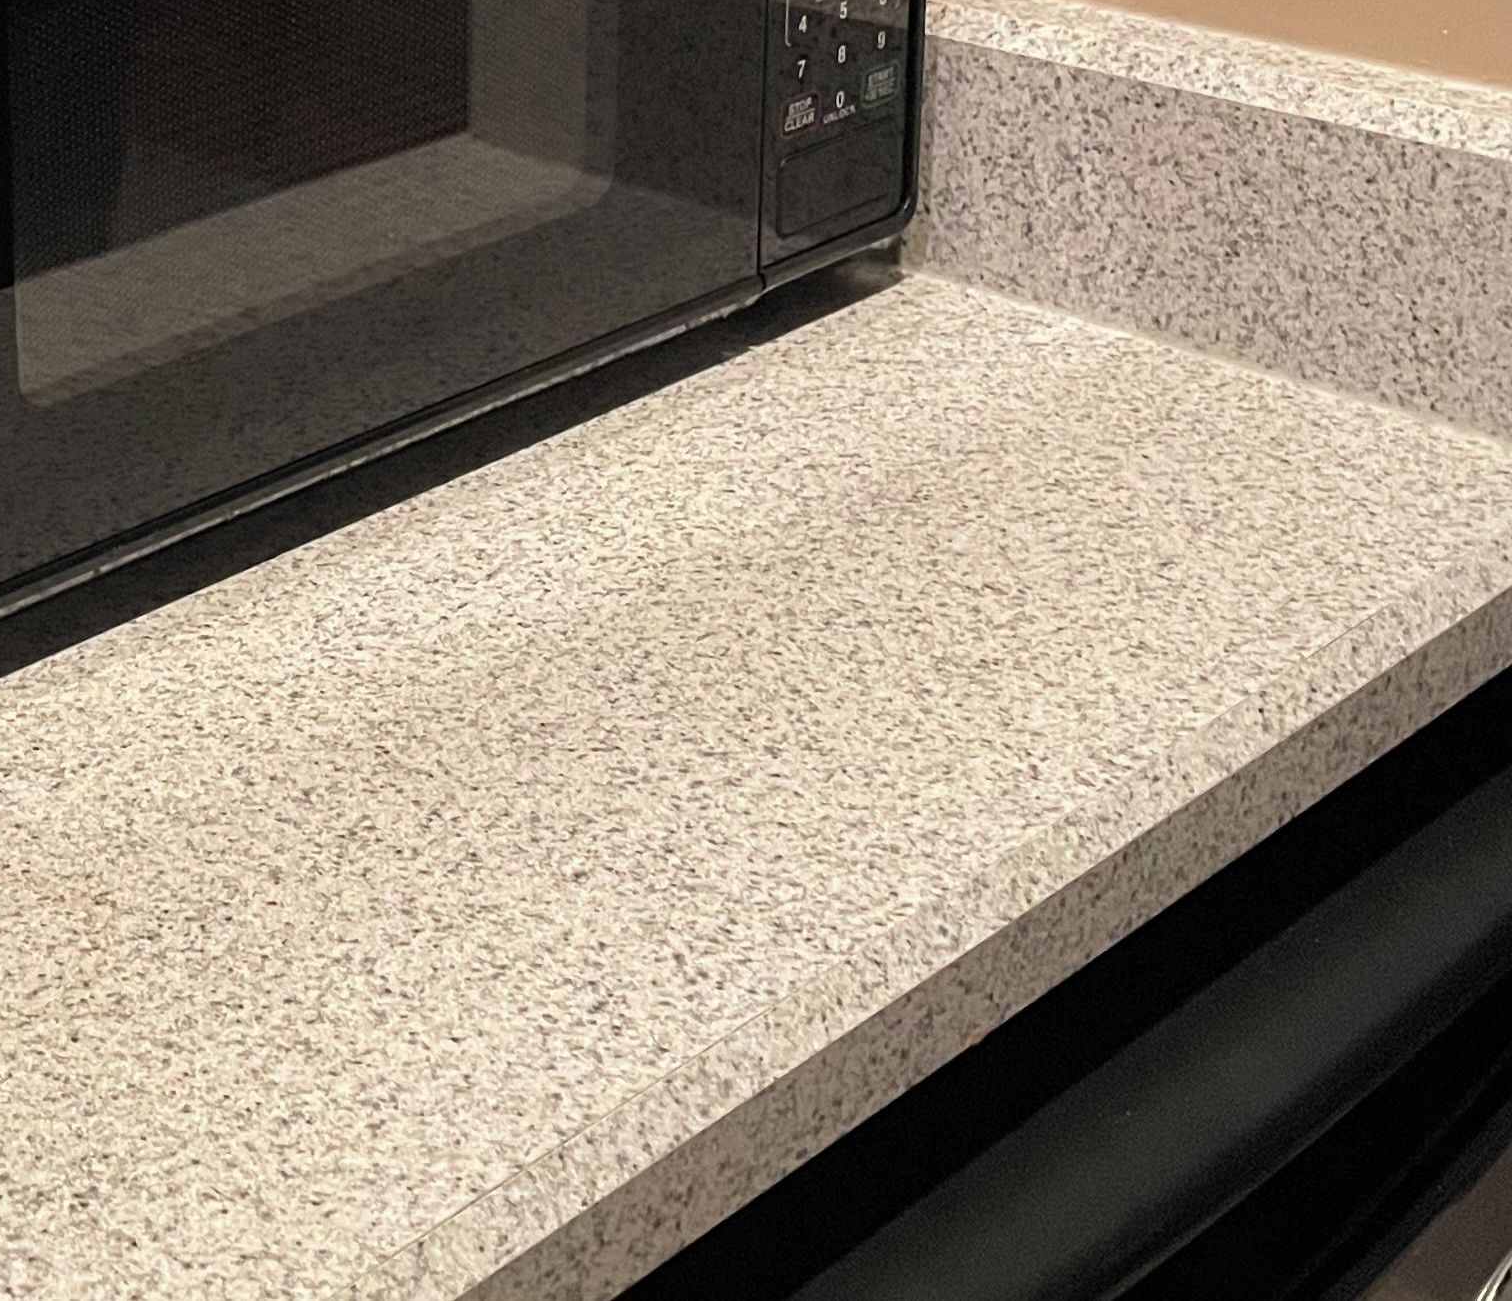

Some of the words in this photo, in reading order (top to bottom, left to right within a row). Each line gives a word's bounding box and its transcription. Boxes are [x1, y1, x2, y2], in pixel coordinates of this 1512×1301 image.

[839, 0, 848, 20] 5
[798, 15, 807, 33] 4
[877, 30, 886, 49] 9
[837, 45, 846, 64] 8
[797, 59, 806, 78] 7
[788, 96, 812, 115] STOP
[835, 90, 845, 108] 0
[784, 111, 814, 131] CLEAR
